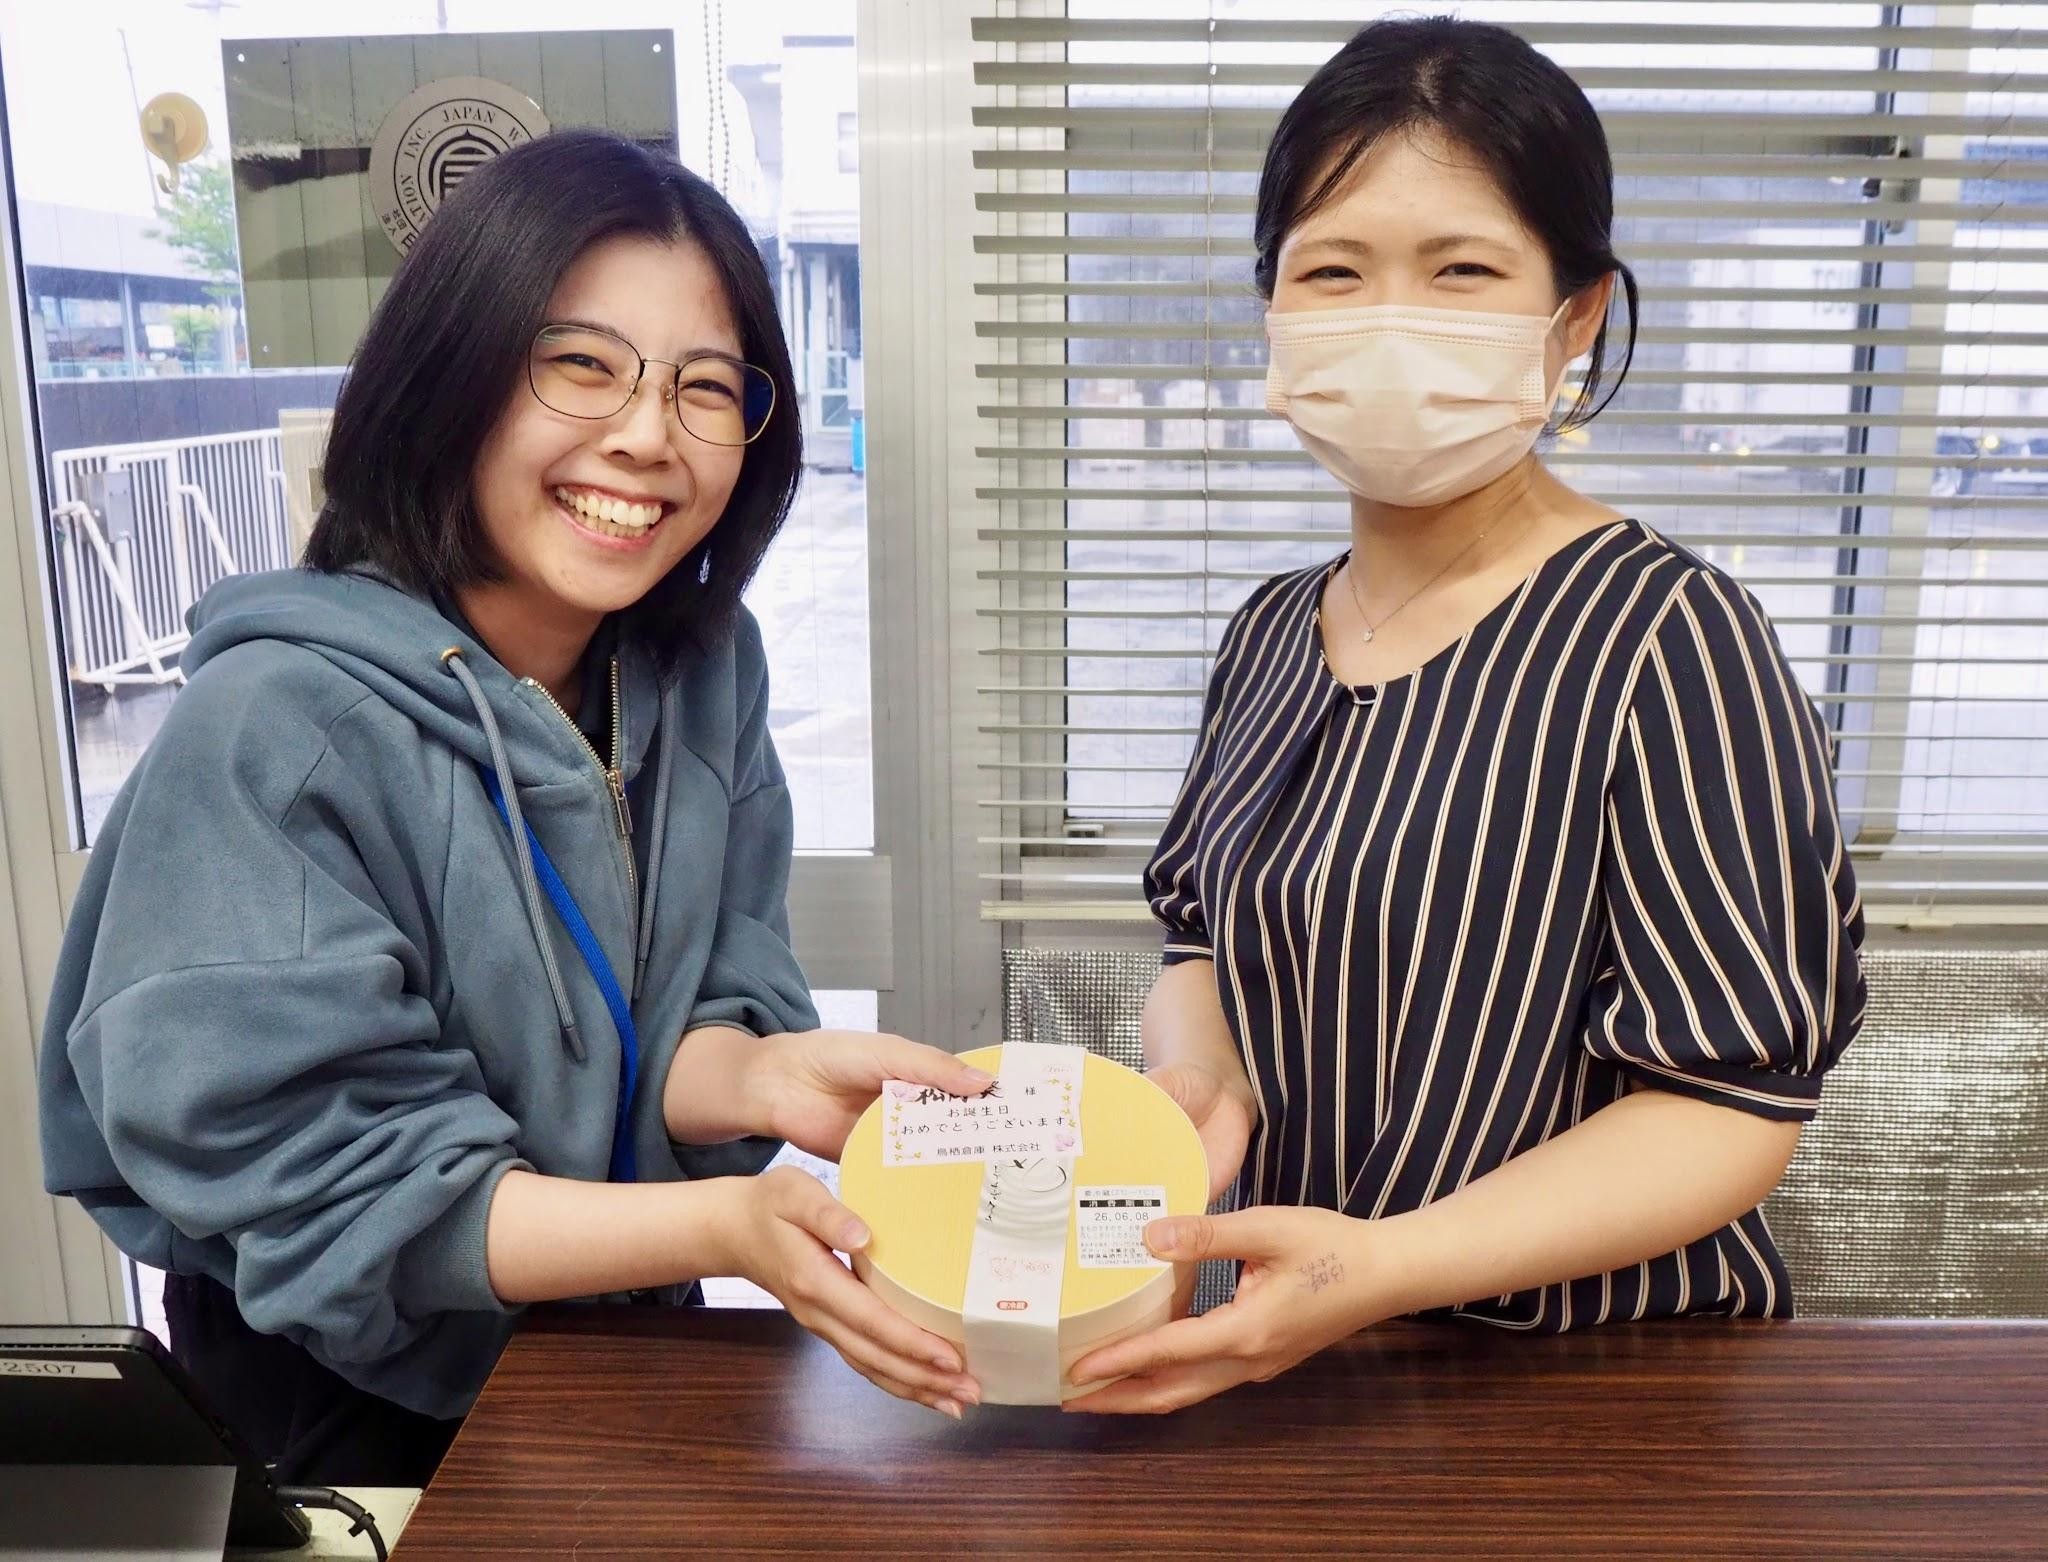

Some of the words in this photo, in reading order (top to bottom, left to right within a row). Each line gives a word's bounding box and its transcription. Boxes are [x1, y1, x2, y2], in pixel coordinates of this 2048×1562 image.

[404, 127, 431, 160] INC.
[442, 106, 497, 125] JAPAN
[1025, 1085, 1038, 1097] 様
[948, 1104, 1009, 1118] お誕生日
[902, 1116, 1065, 1135] おめでとうございます
[937, 1145, 985, 1157] 鳥栖倉庫
[993, 1142, 1040, 1153] 株式会社
[1094, 1211, 1150, 1222] 26.06.08
[3, 1361, 75, 1375] 2507
